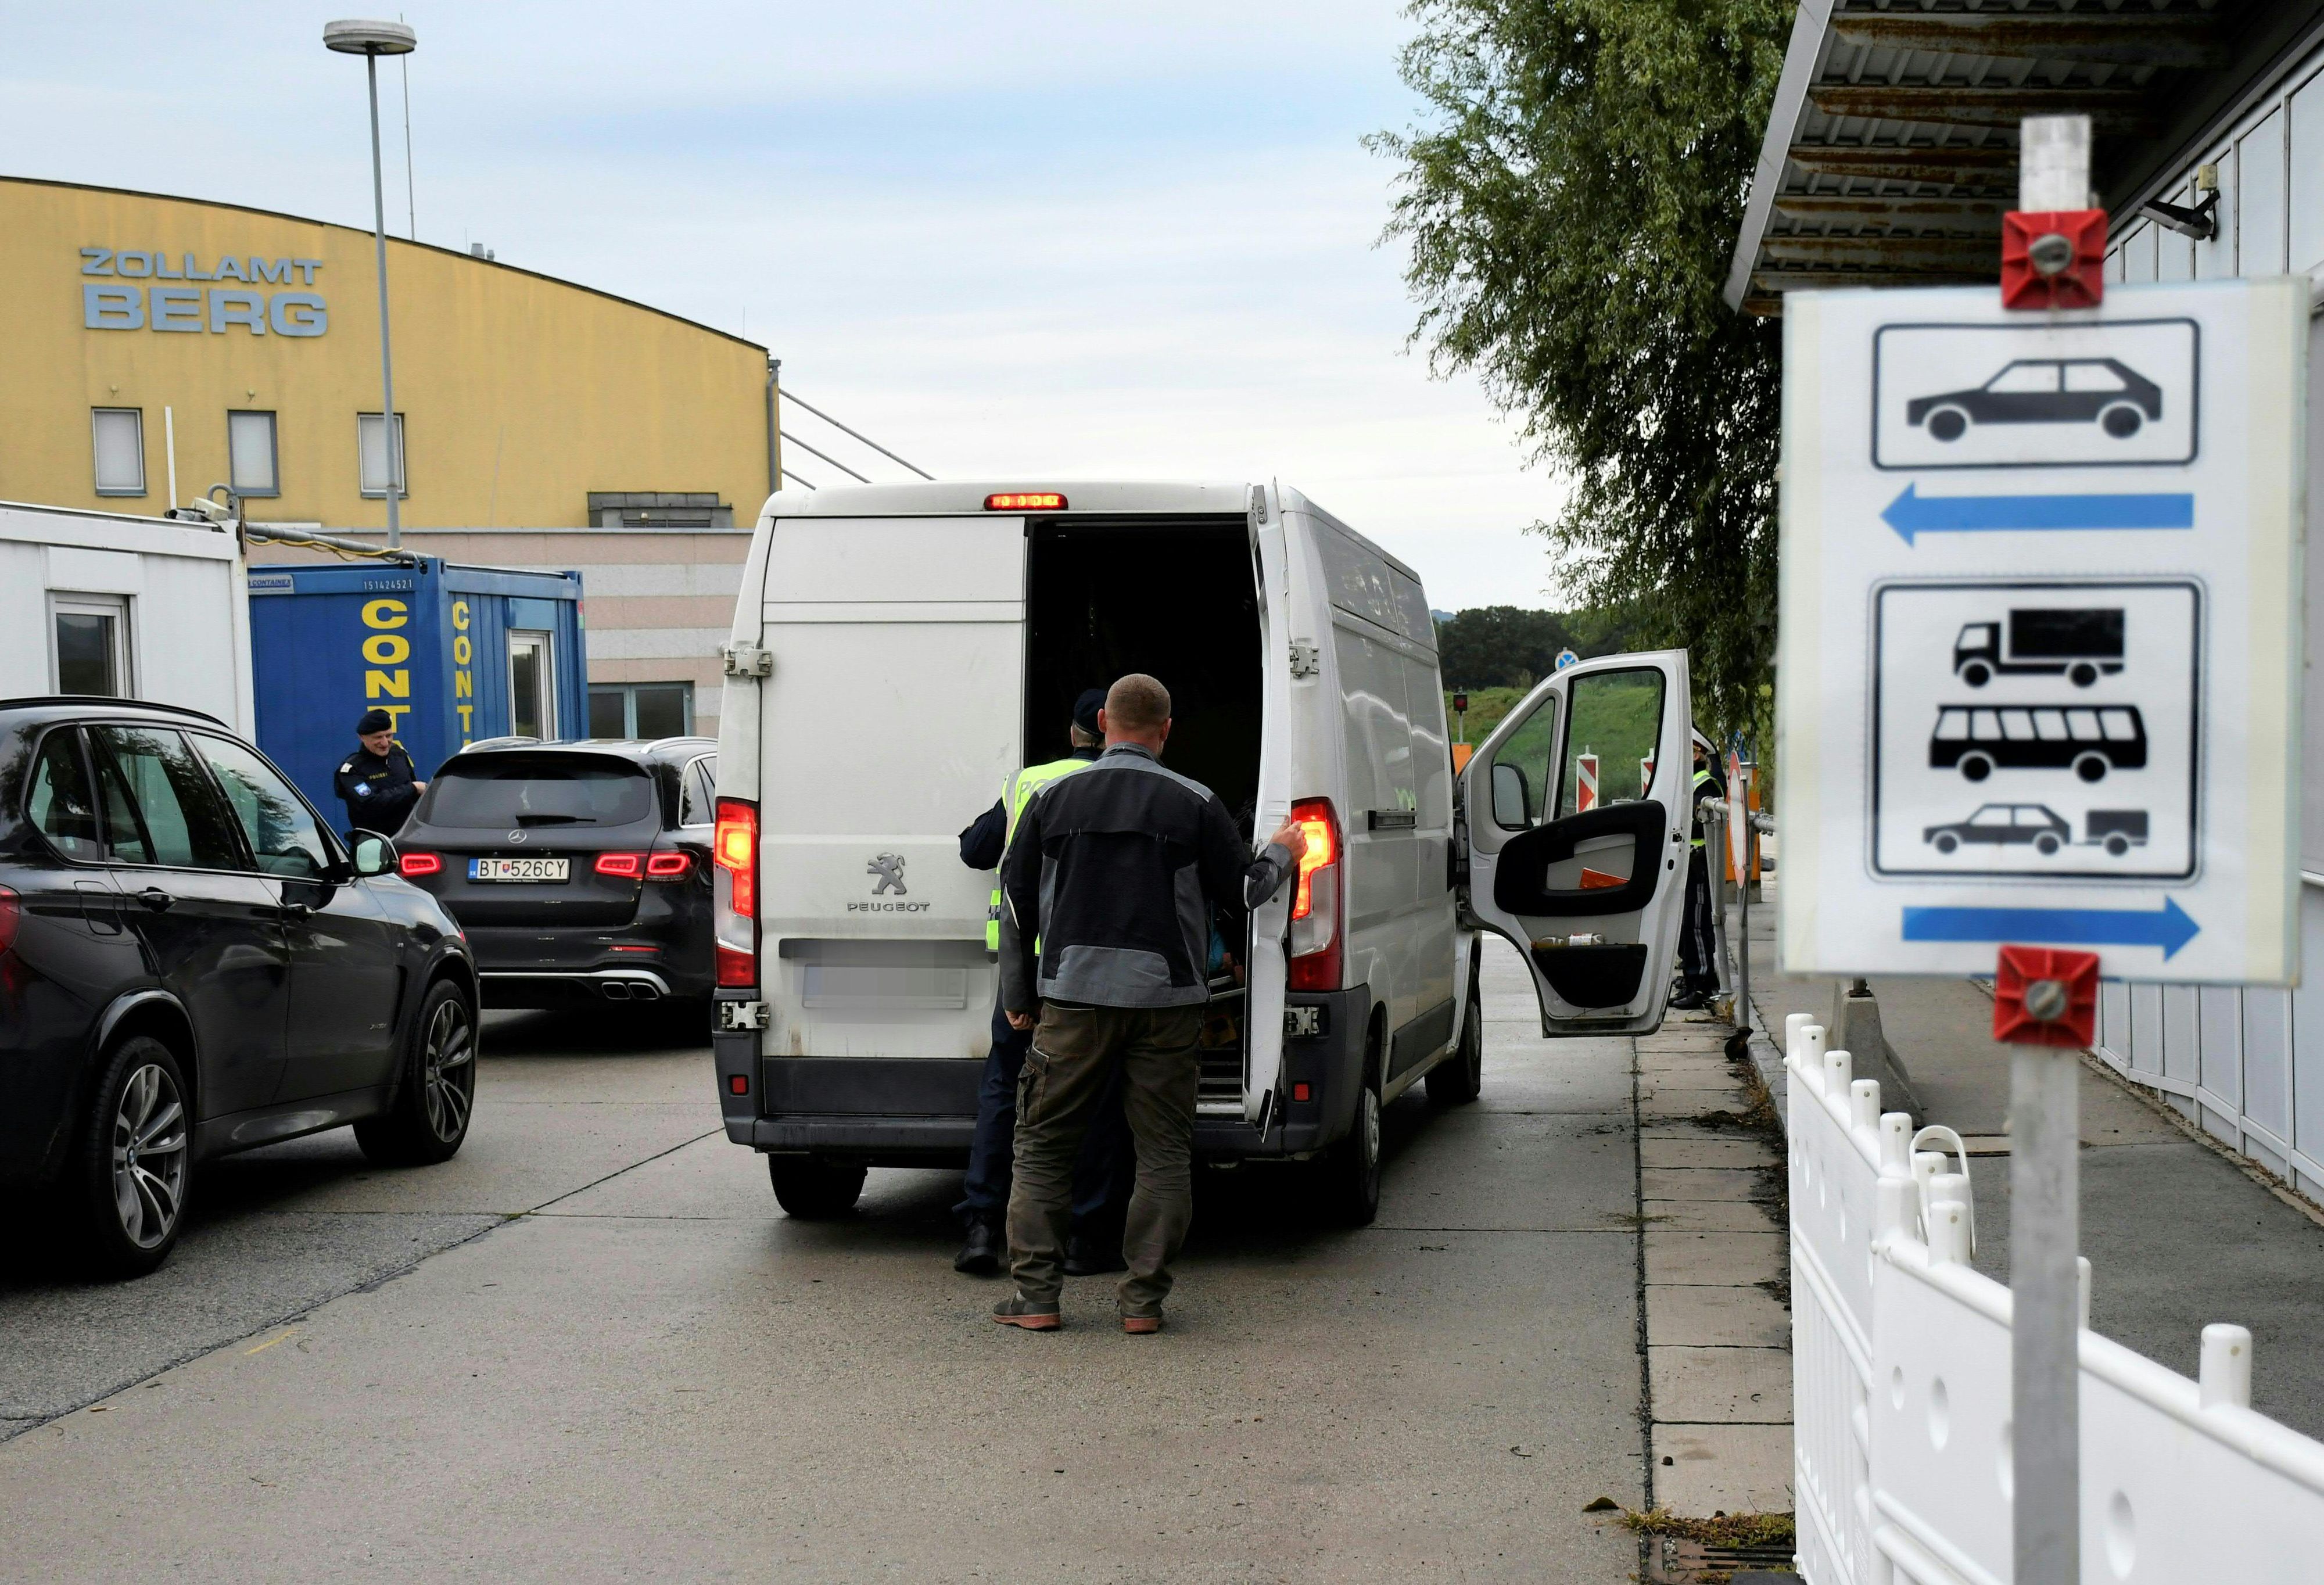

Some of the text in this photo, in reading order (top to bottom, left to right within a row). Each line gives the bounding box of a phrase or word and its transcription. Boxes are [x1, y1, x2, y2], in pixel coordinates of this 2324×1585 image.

[80, 248, 323, 285] ZOLLAMT
[83, 284, 328, 337] BERG
[364, 579, 412, 590] 151424521
[480, 860, 501, 877] BT
[511, 860, 565, 877] 526CY
[847, 902, 930, 912] PEUGEOT
